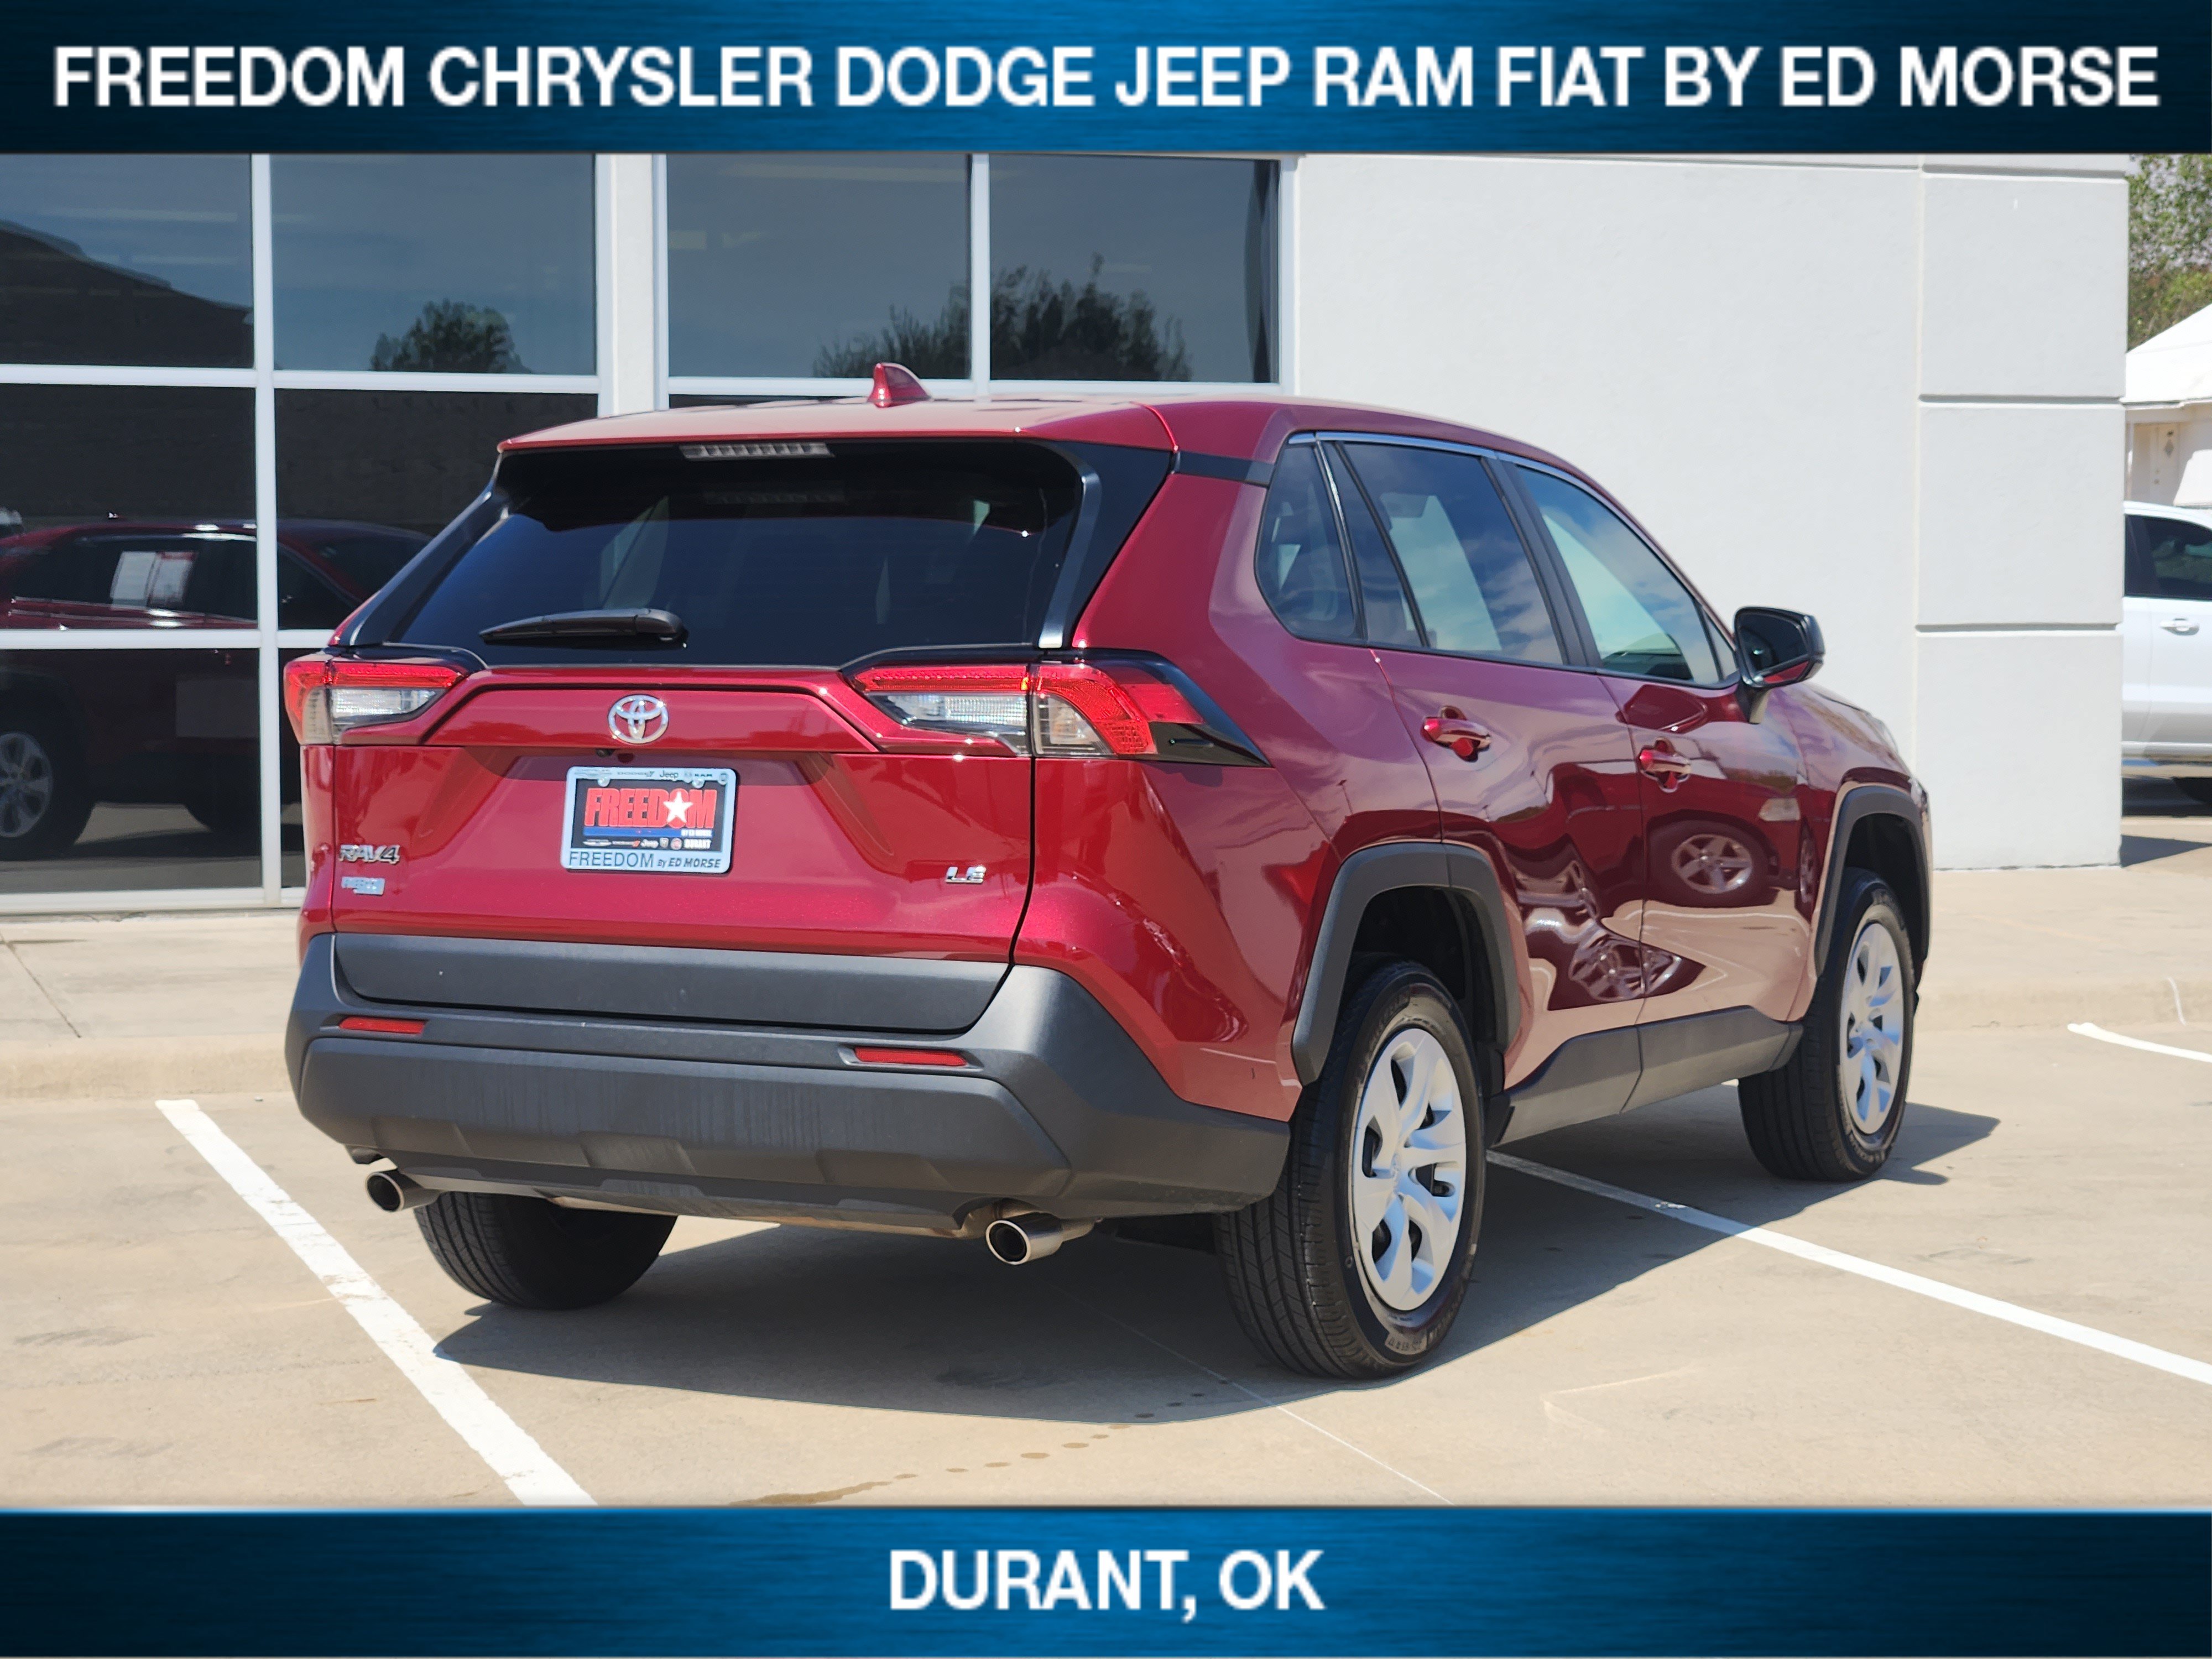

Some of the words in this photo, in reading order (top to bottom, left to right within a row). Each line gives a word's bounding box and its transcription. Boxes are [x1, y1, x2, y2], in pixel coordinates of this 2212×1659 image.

[585, 787, 717, 828] FREEDOM
[339, 844, 400, 864] RAV4
[568, 851, 654, 868] FREEDOM
[668, 857, 682, 867] ED
[684, 858, 722, 868] MORSE
[945, 866, 987, 883] LE
